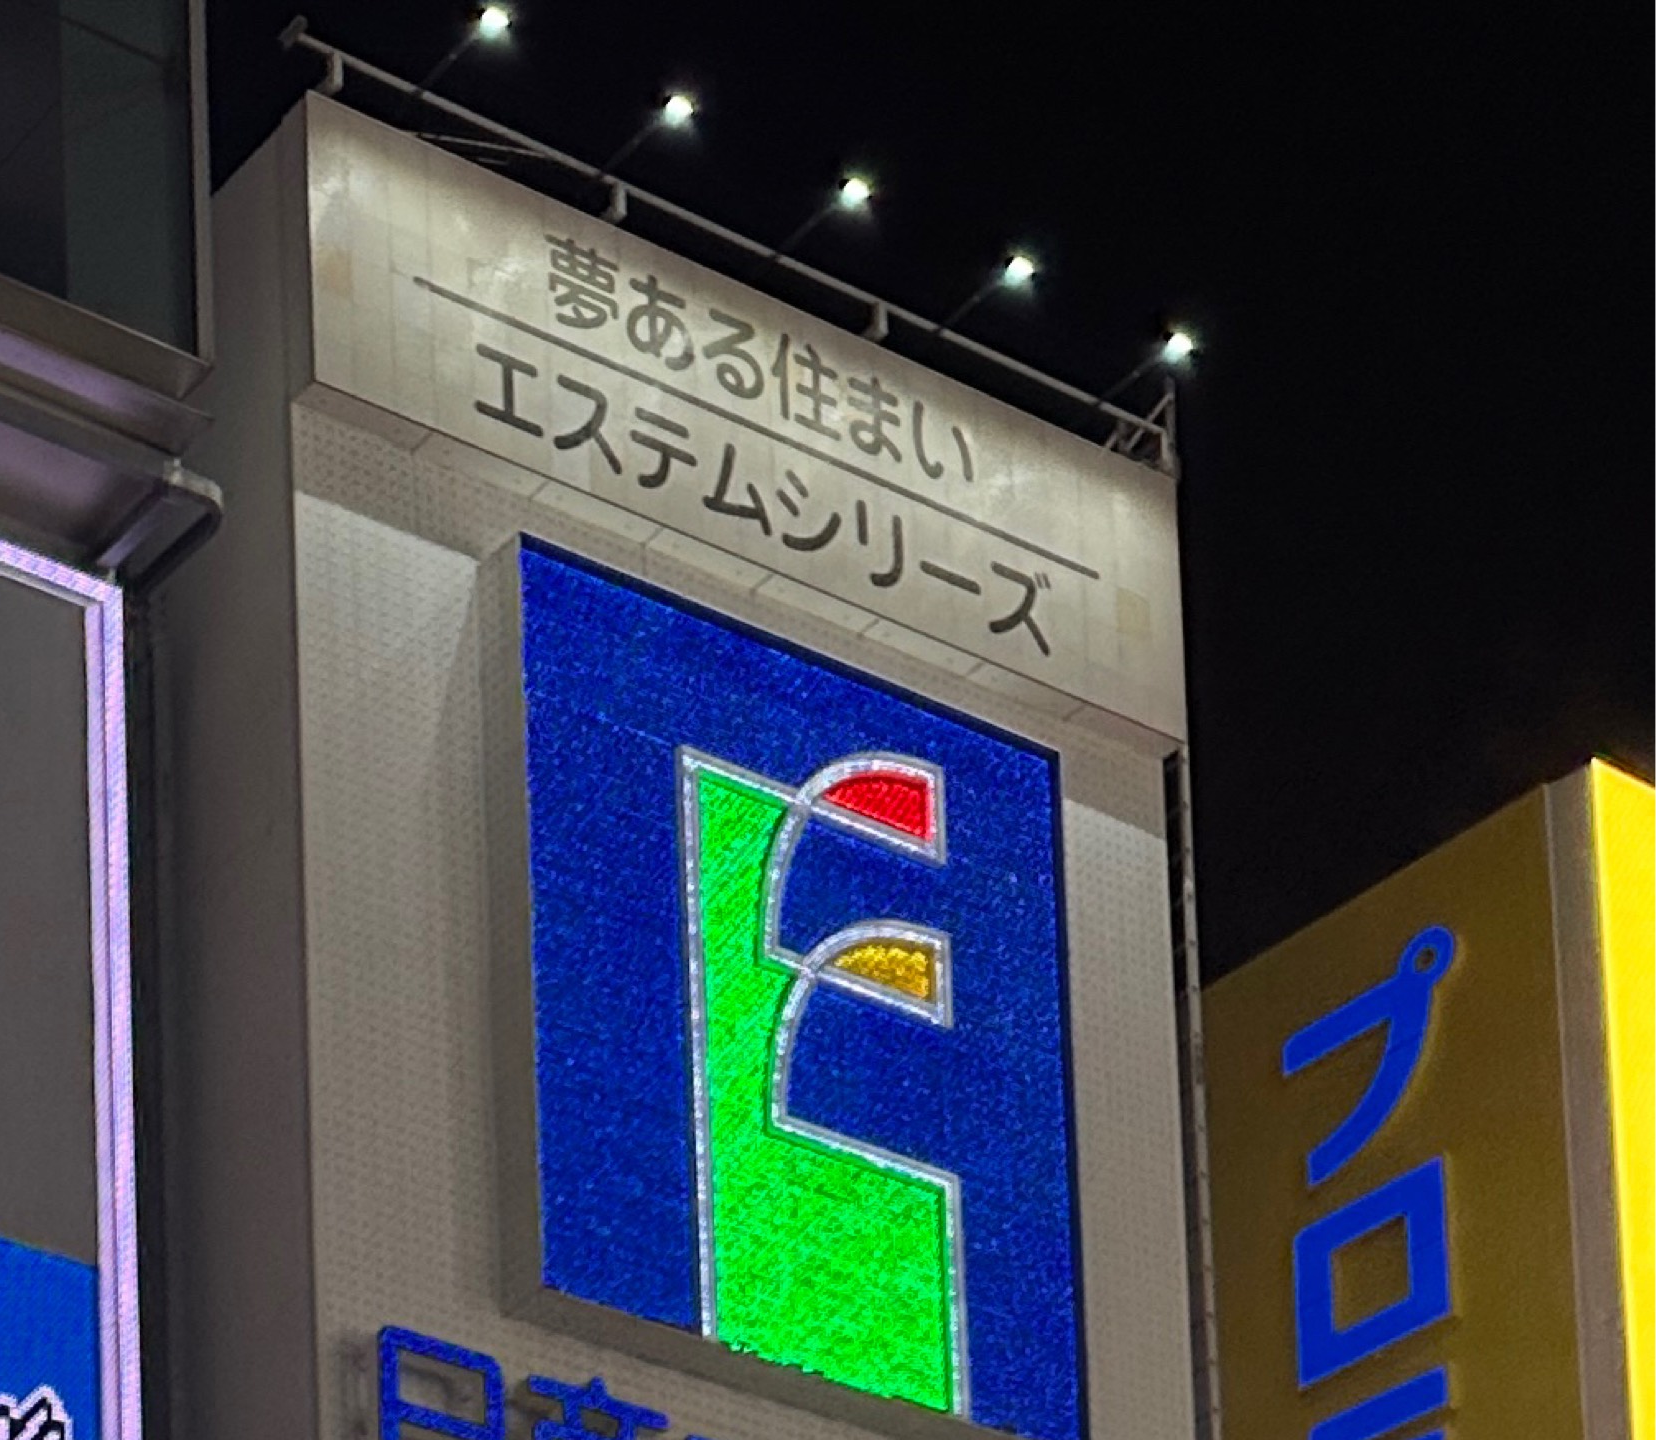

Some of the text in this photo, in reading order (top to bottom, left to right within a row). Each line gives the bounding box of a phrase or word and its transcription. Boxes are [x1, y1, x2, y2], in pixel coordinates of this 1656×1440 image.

[545, 235, 976, 483] 夢ある住まい
[475, 343, 1050, 656] エステムシリーズ
